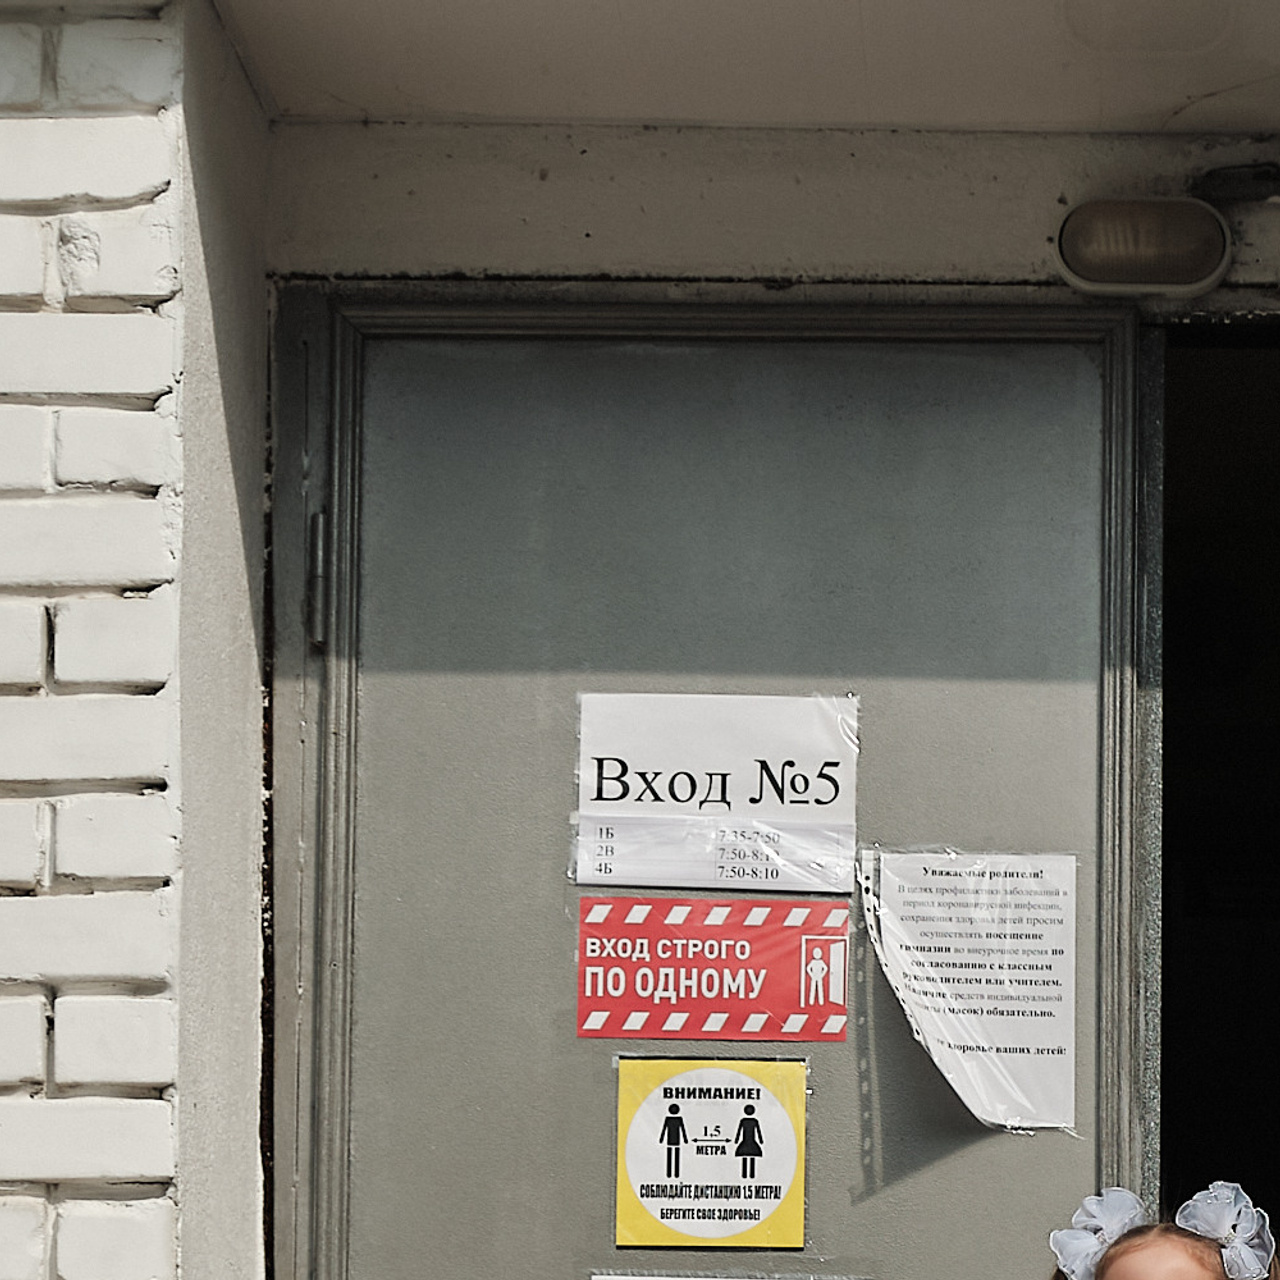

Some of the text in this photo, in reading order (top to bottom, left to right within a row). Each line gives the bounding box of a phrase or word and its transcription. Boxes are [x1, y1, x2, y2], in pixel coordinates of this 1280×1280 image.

[590, 757, 840, 811] Вход №5
[597, 827, 615, 840] 1Б
[596, 845, 615, 857] 2В
[595, 862, 780, 880] 4Б 7:50-8:10
[586, 938, 751, 962] ВХОД СТРОГО
[585, 966, 767, 1004] ПО ОДНОМУ
[663, 1087, 761, 1100] ВНИМАНИЕ!
[703, 1125, 721, 1138] 1,5
[696, 1145, 727, 1156] МЕТРА
[640, 1182, 692, 1200] СОБЛЮДАЙТЕ
[693, 1185, 741, 1200] ДИСТАНЦИЮ
[754, 1186, 782, 1200] МЕТРА!
[660, 1208, 760, 1221] БЕРЕГИТЕ СВОЕ ЗДОРОВЬЕ!
